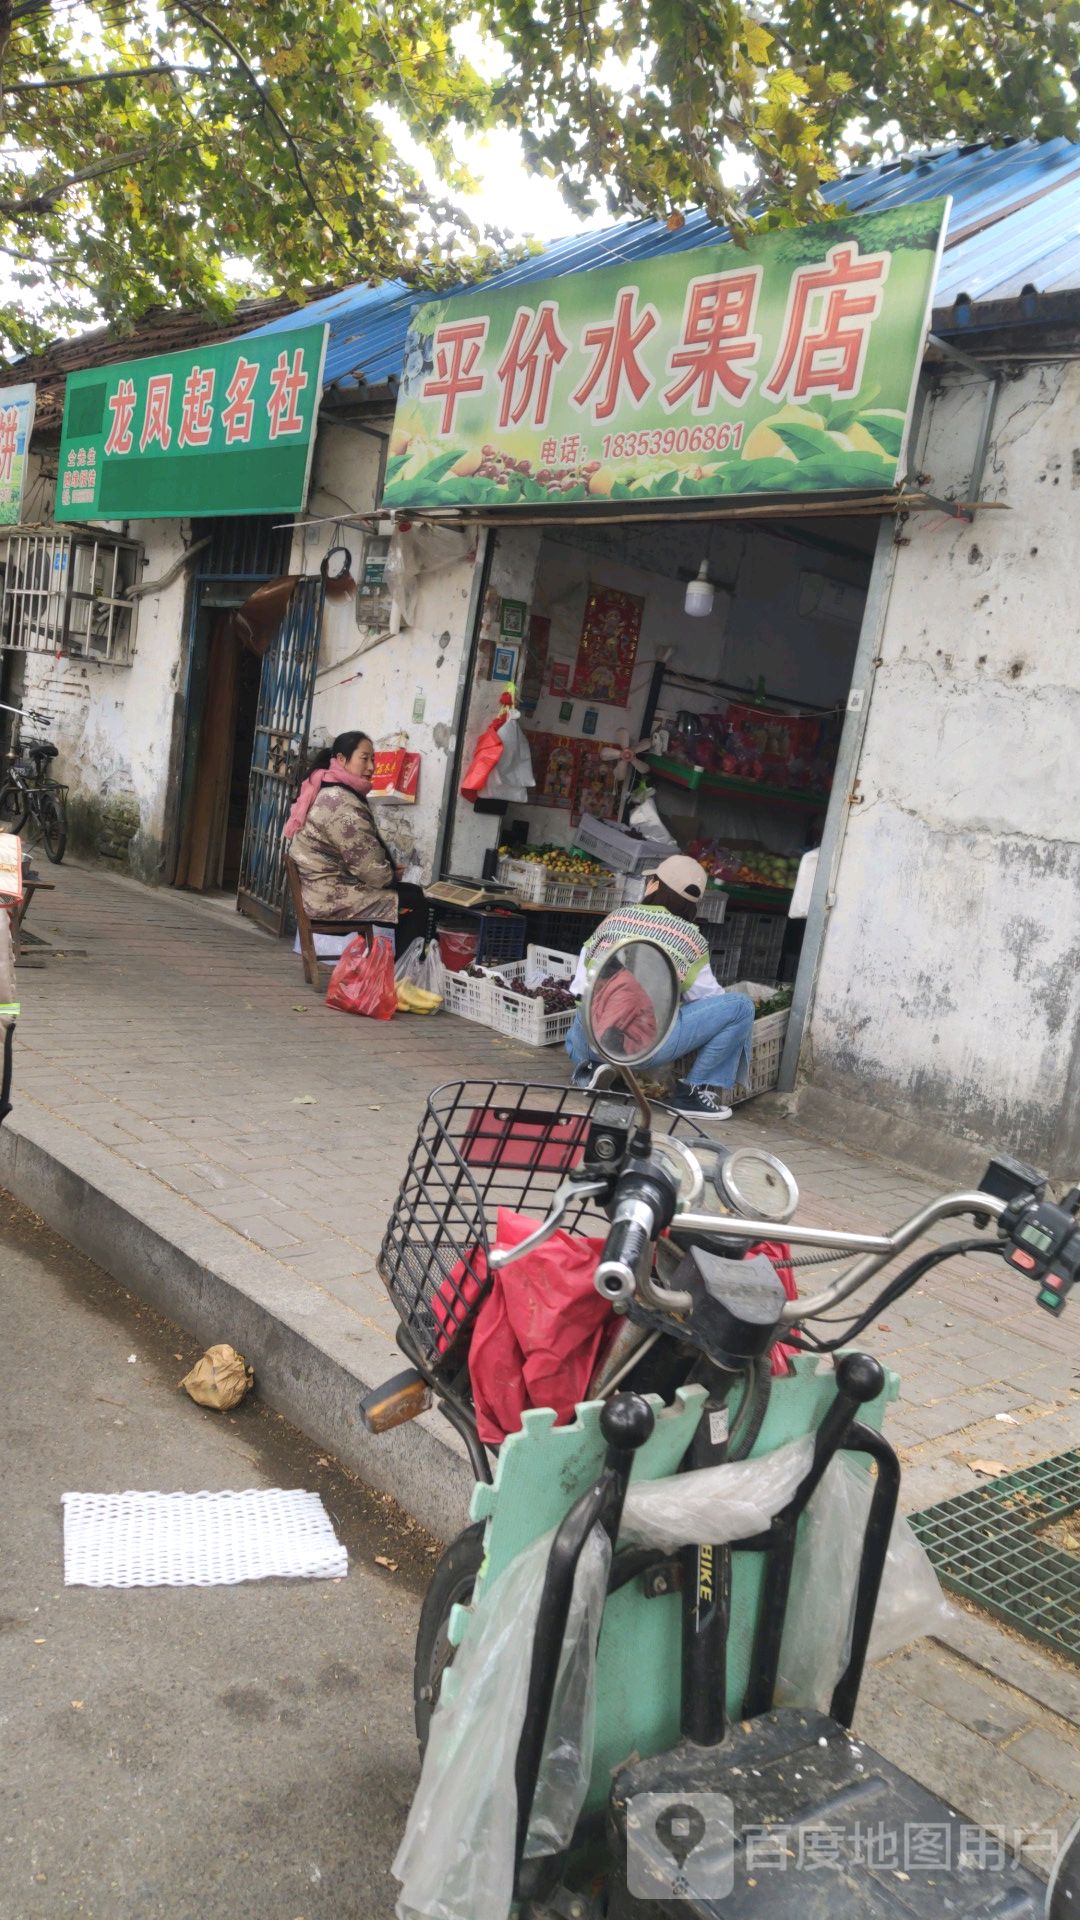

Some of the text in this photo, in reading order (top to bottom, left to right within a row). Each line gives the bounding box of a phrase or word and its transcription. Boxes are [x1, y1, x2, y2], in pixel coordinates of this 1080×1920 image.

[421, 245, 888, 437] 平价水果店
[104, 347, 308, 457] 龙凤起名社
[601, 420, 745, 460] 18353906861
